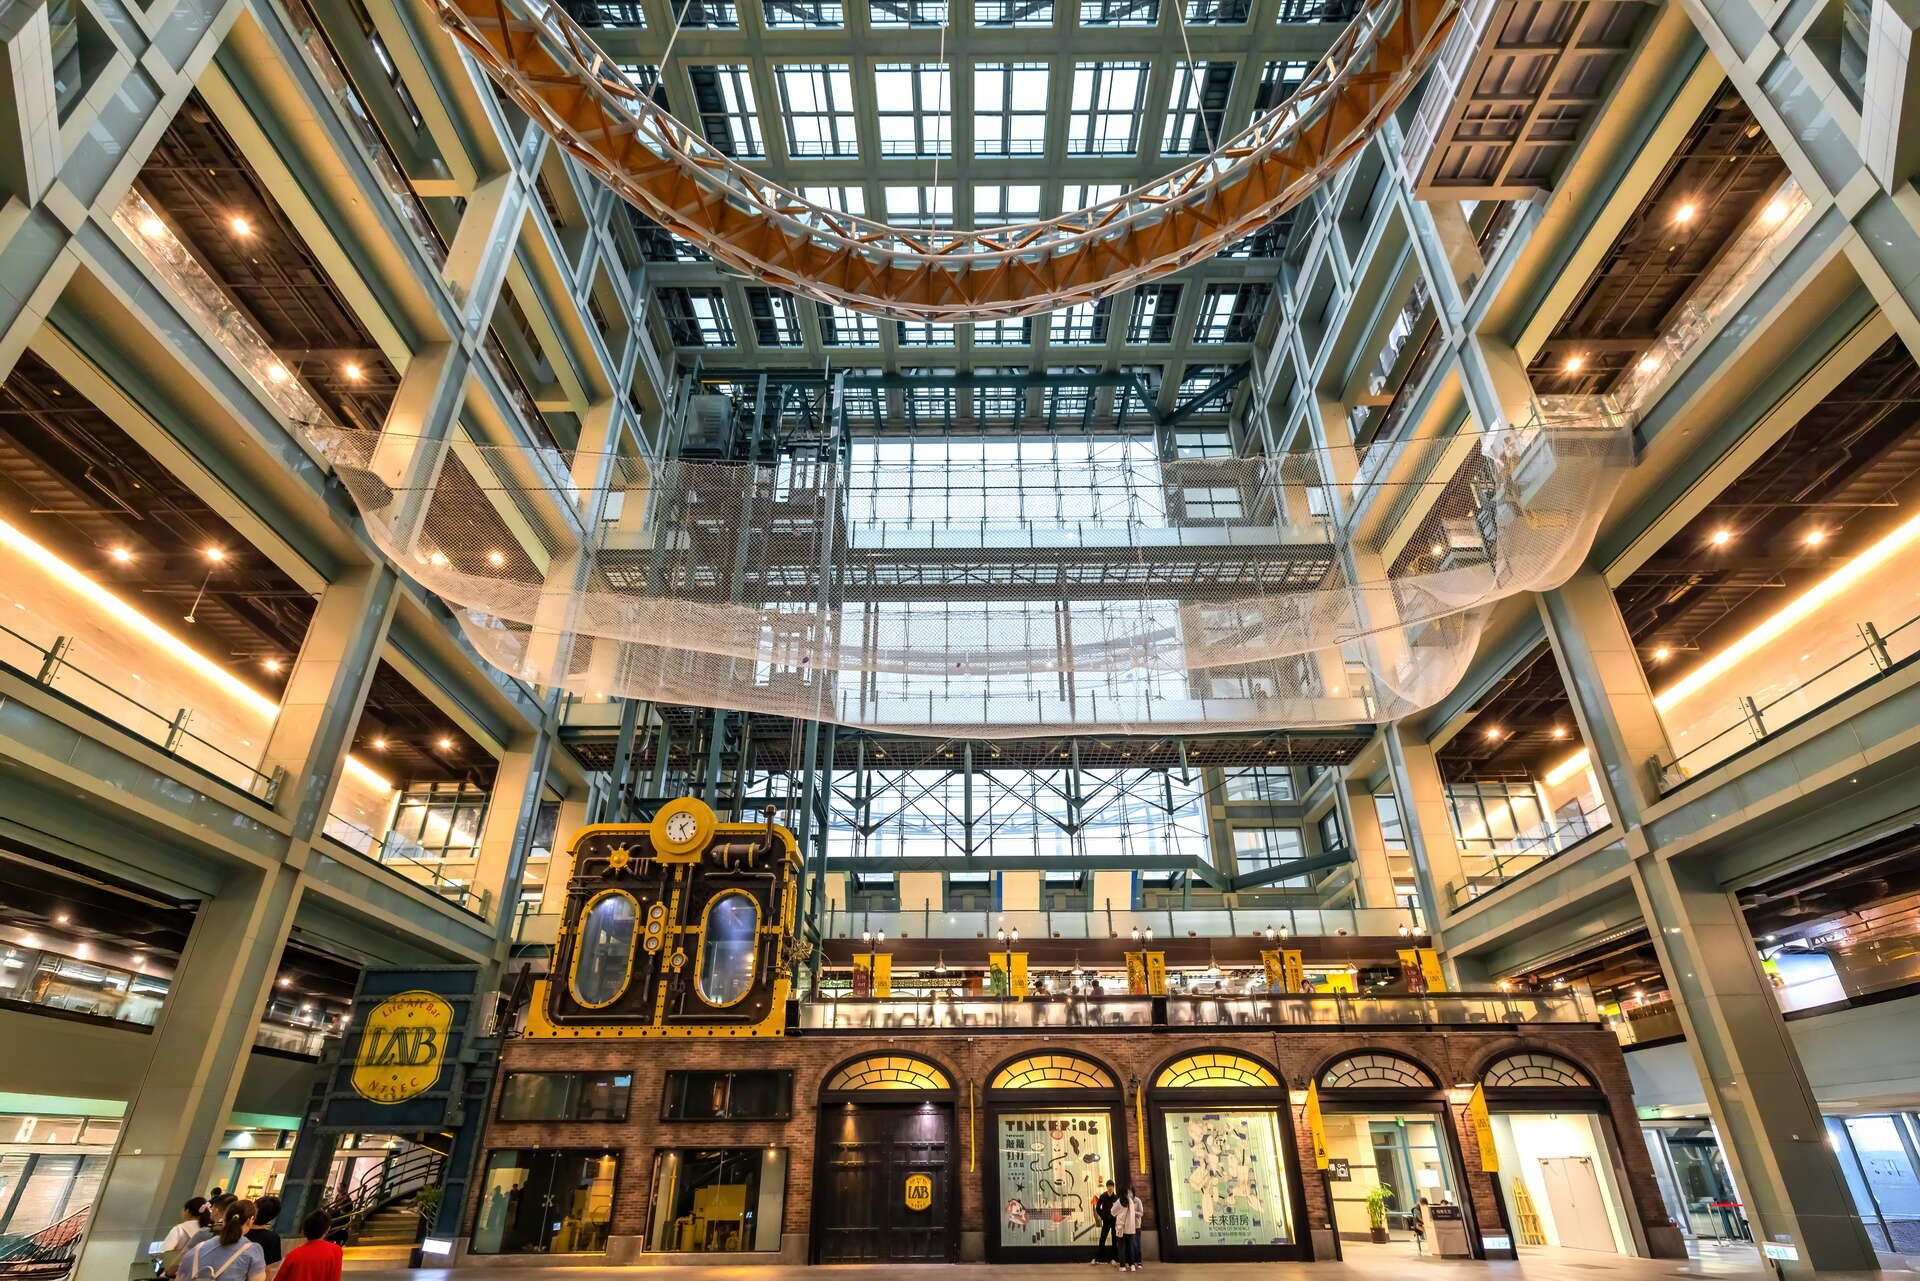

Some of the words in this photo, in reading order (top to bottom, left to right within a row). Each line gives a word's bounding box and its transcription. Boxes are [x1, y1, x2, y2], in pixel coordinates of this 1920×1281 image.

[426, 1001, 441, 1018] Bar
[365, 1026, 437, 1067] LAB
[369, 1077, 418, 1093] NTSEC
[908, 1186, 929, 1198] LAB
